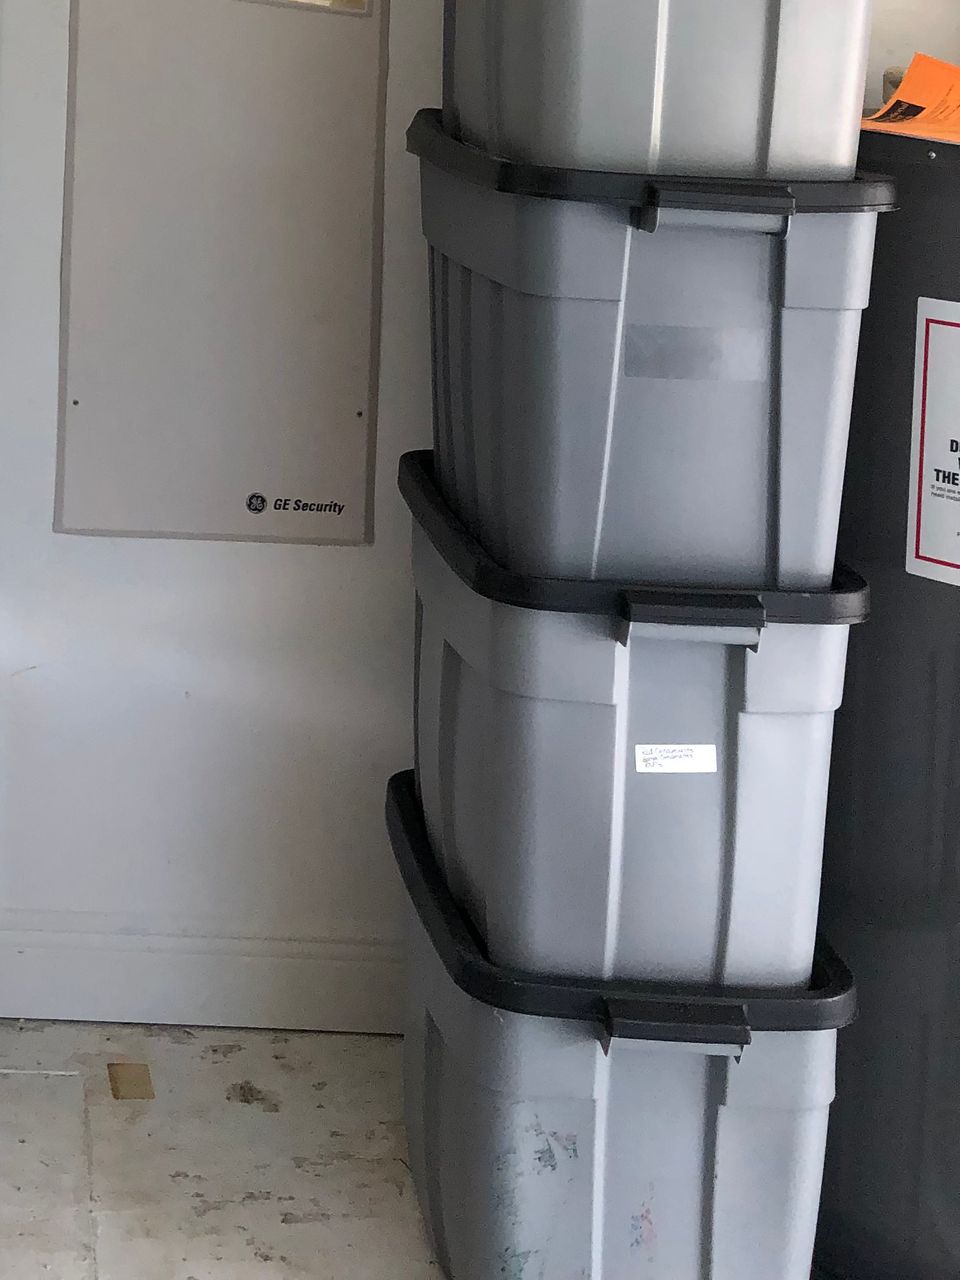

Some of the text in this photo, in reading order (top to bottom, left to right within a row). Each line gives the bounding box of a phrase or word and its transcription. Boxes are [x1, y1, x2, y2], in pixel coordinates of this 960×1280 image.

[950, 439, 960, 453] D
[934, 468, 960, 487] THE
[273, 498, 291, 510] GE
[293, 499, 345, 515] Security
